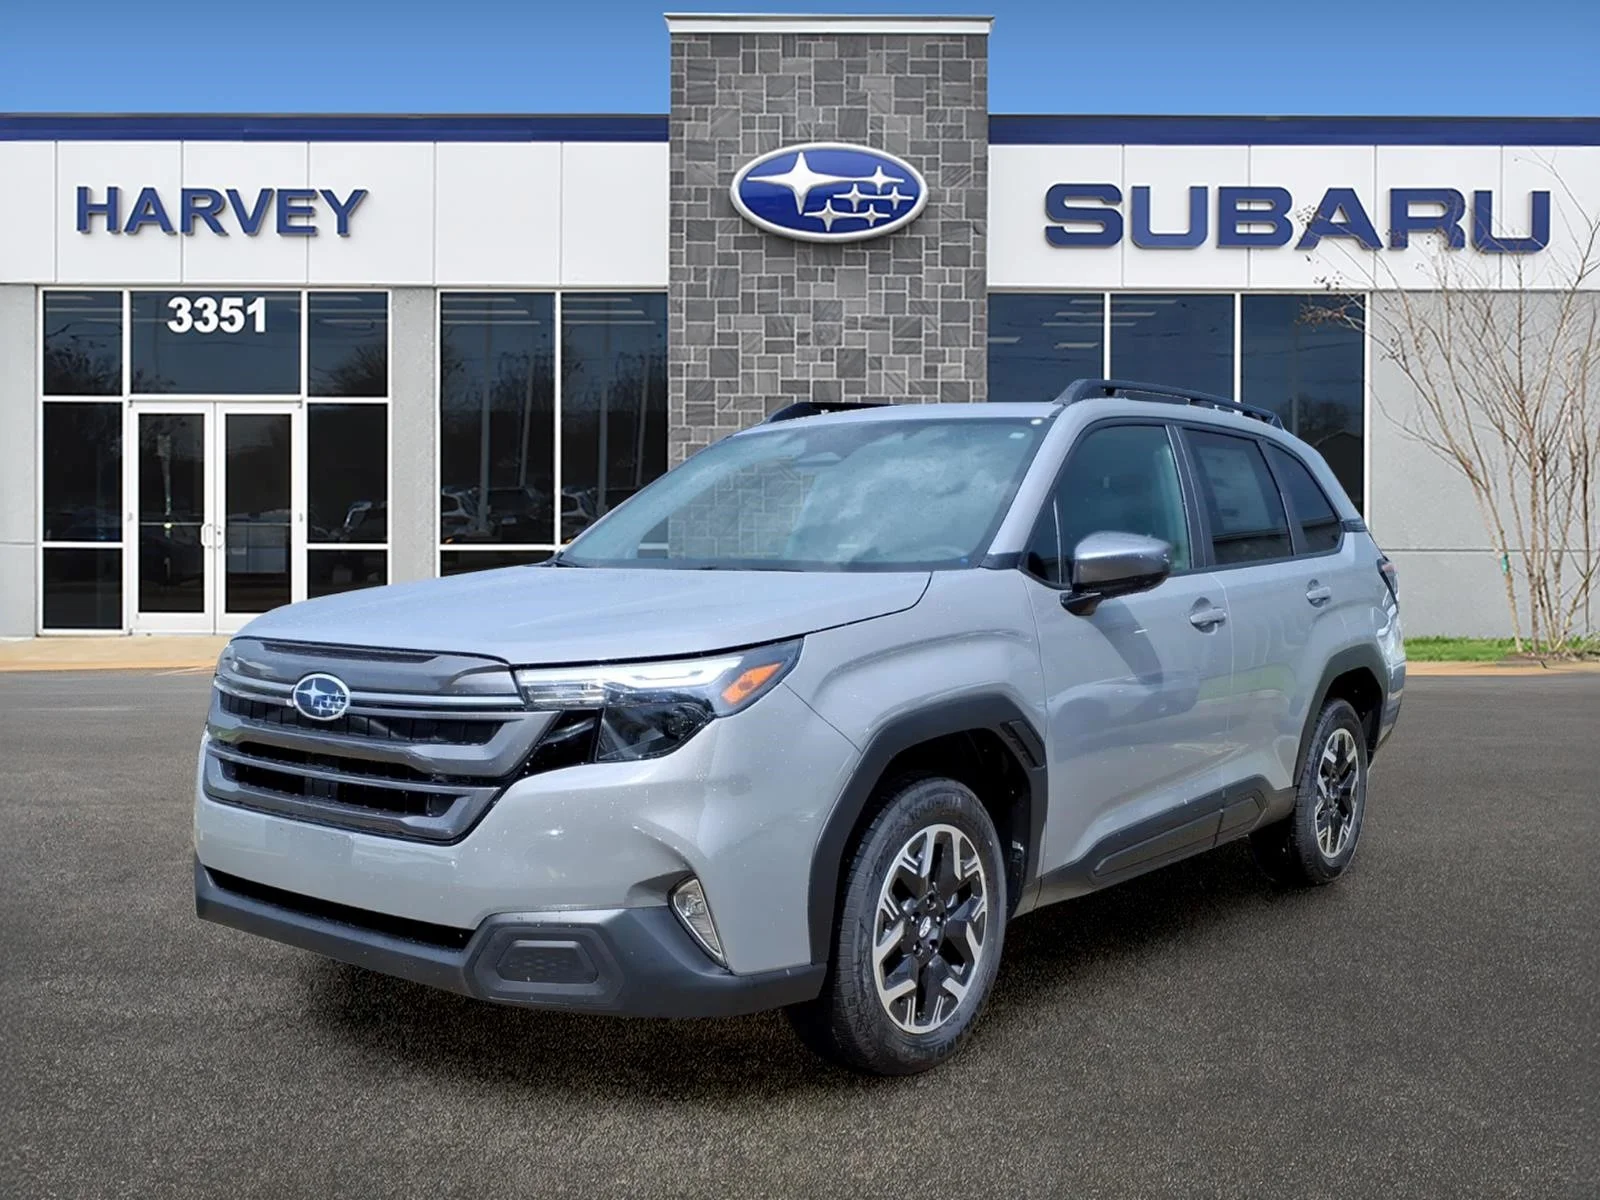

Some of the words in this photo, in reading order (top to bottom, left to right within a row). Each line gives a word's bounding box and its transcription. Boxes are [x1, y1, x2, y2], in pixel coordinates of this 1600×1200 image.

[77, 186, 367, 237] HARVEY
[1045, 183, 1550, 251] SUBARU
[166, 296, 267, 334] 3351
